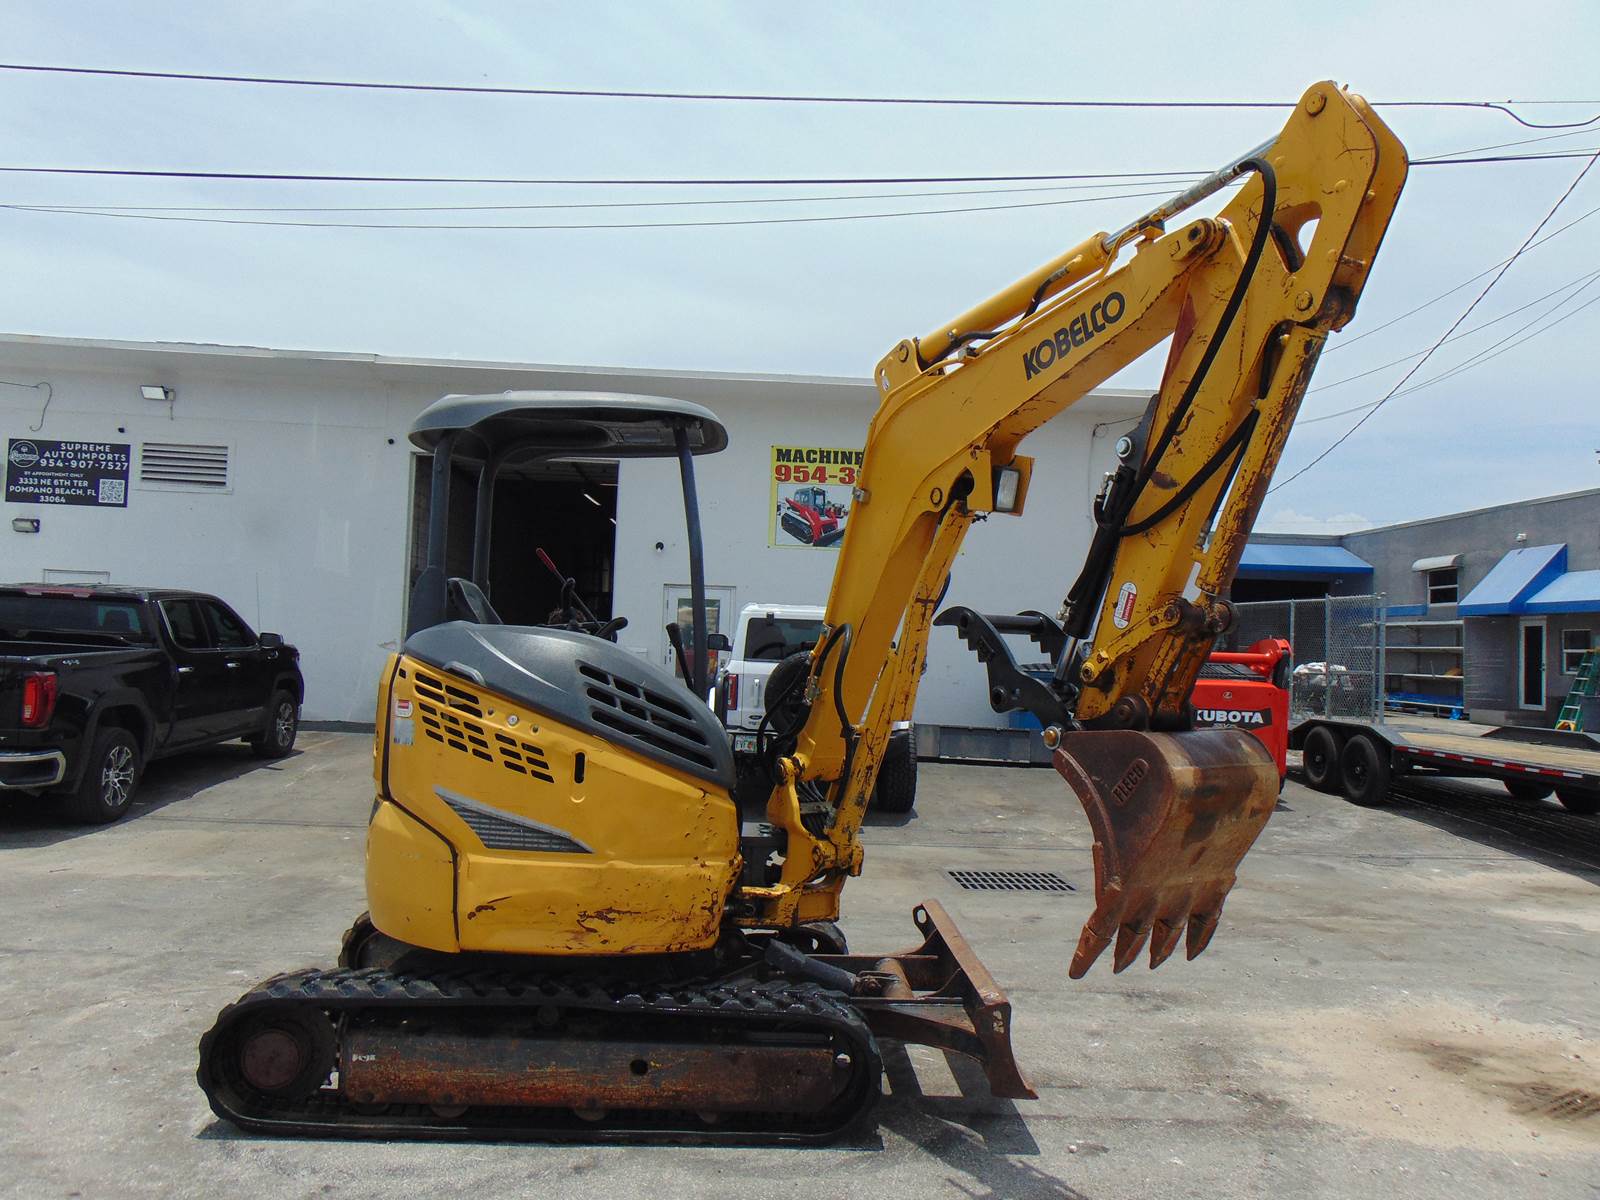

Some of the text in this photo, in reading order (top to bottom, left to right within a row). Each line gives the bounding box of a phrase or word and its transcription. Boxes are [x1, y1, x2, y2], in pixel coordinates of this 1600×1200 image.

[1022, 291, 1126, 382] KOBELCO
[60, 442, 111, 452] SUPREME
[43, 451, 74, 459] AUTO
[78, 452, 126, 461] IMPORTS
[40, 458, 129, 471] 954-907-7527
[18, 477, 38, 485] 3333
[53, 479, 71, 487] 6TH
[9, 485, 53, 494] POMPANO
[55, 487, 85, 497] BEACH,
[39, 495, 66, 503] 33064
[1196, 709, 1264, 724] KUBOTA
